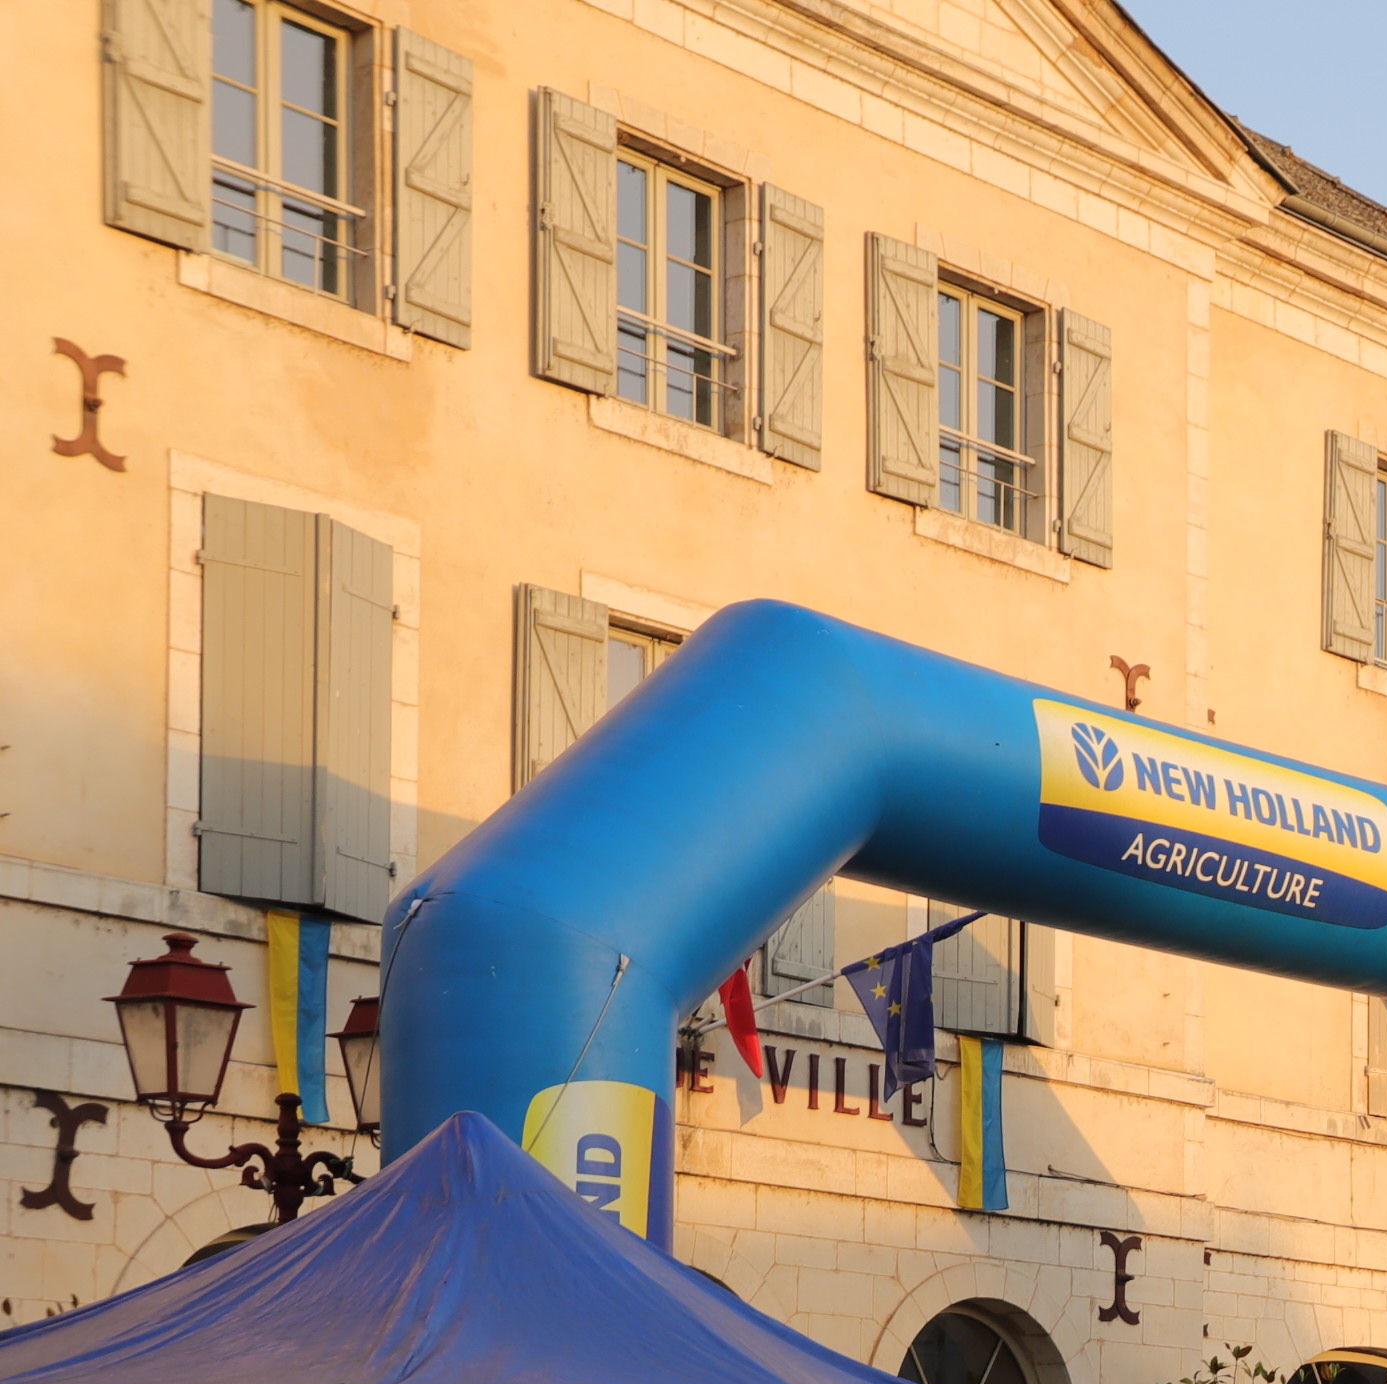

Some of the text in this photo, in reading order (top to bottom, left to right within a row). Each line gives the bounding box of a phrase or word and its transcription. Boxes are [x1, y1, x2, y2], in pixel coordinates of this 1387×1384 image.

[1132, 752, 1383, 854] NEW HOLLAND
[1121, 831, 1324, 909] AGRICULTURE
[676, 1044, 928, 1127] E VILLE
